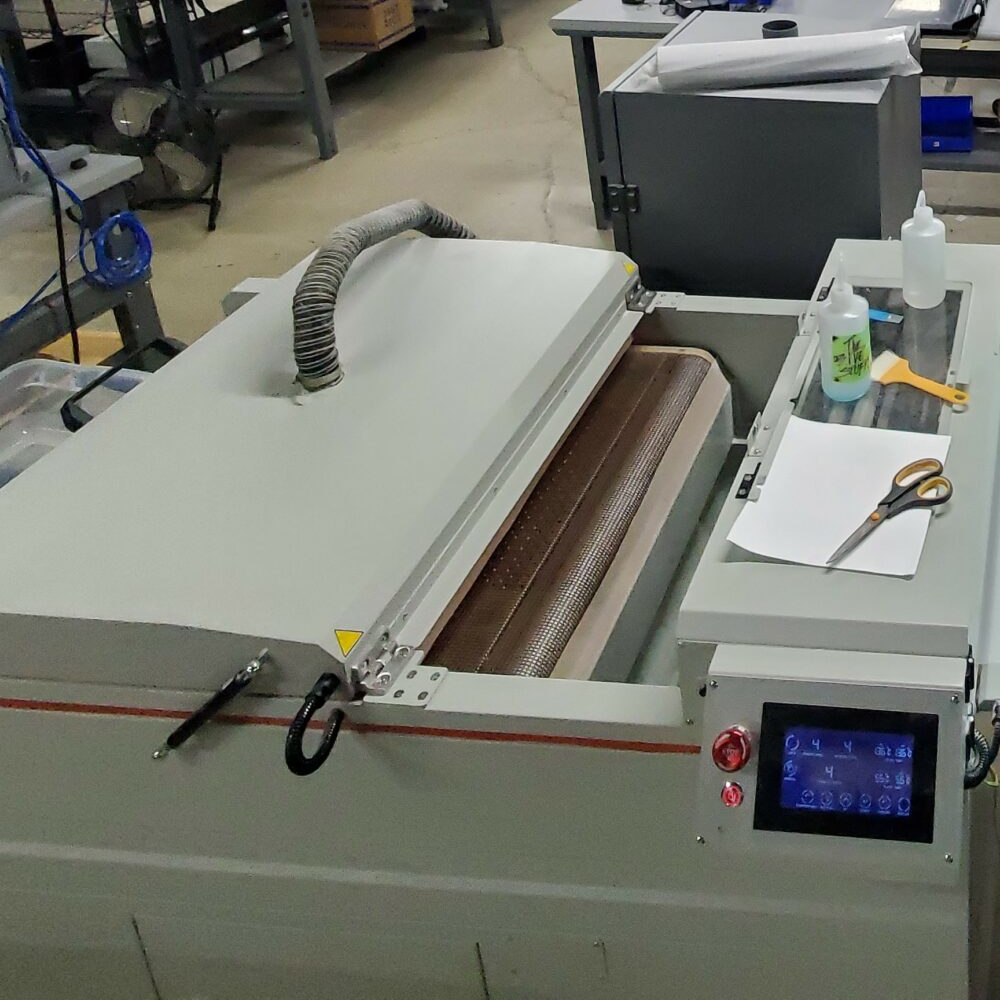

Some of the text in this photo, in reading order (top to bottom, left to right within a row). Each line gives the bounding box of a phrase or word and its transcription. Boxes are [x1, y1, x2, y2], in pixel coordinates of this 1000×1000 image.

[812, 738, 853, 753] 4 4
[825, 765, 834, 779] 4
